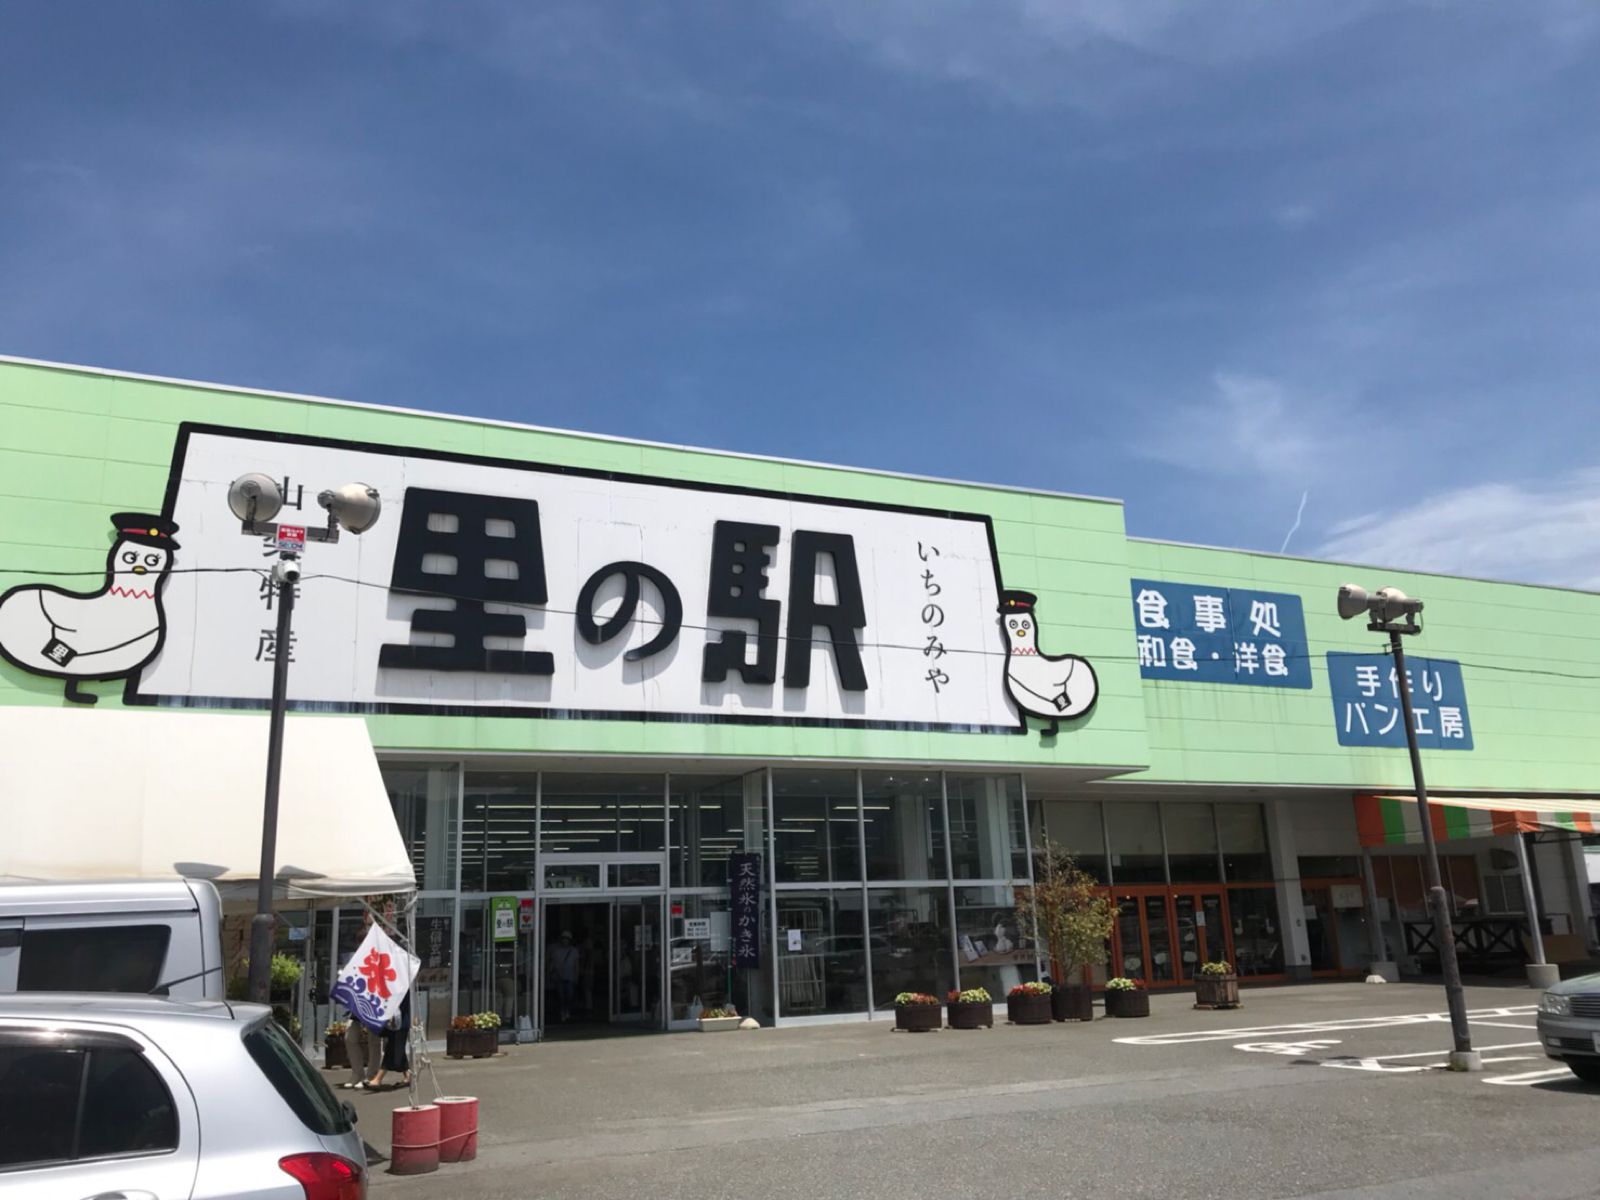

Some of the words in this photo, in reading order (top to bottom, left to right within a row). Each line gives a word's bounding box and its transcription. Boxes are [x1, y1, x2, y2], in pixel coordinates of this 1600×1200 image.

[379, 486, 868, 691] 里の駅
[1136, 588, 1281, 638] 食事処
[917, 540, 950, 693] いちのみや
[1137, 635, 1288, 676] 和食・洋食
[1356, 666, 1442, 701] 手作り
[1345, 702, 1464, 739] パン工房
[358, 947, 397, 1000] 氷
